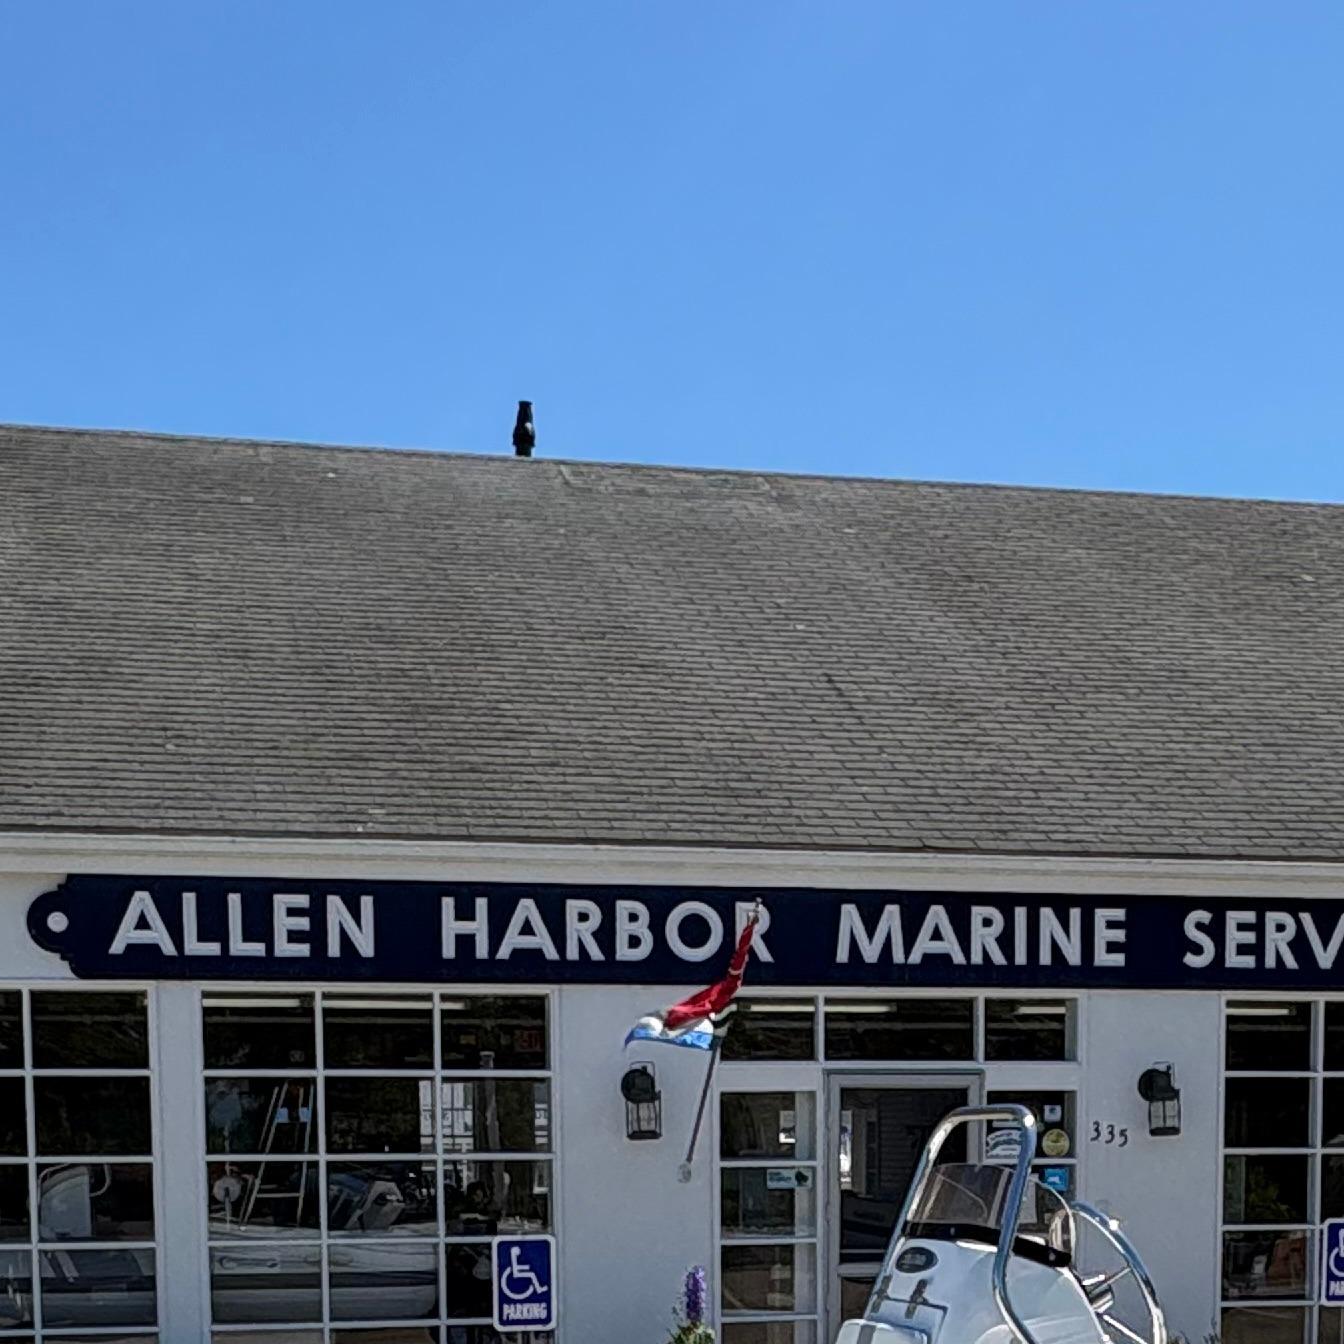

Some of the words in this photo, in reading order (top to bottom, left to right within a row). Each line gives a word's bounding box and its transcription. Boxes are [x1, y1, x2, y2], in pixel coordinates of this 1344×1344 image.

[108, 890, 375, 959] ALLEN
[441, 896, 775, 963] HARBOR
[835, 902, 1127, 968] MARINE
[1089, 1120, 1128, 1148] 335
[502, 1302, 548, 1321] PARKING
